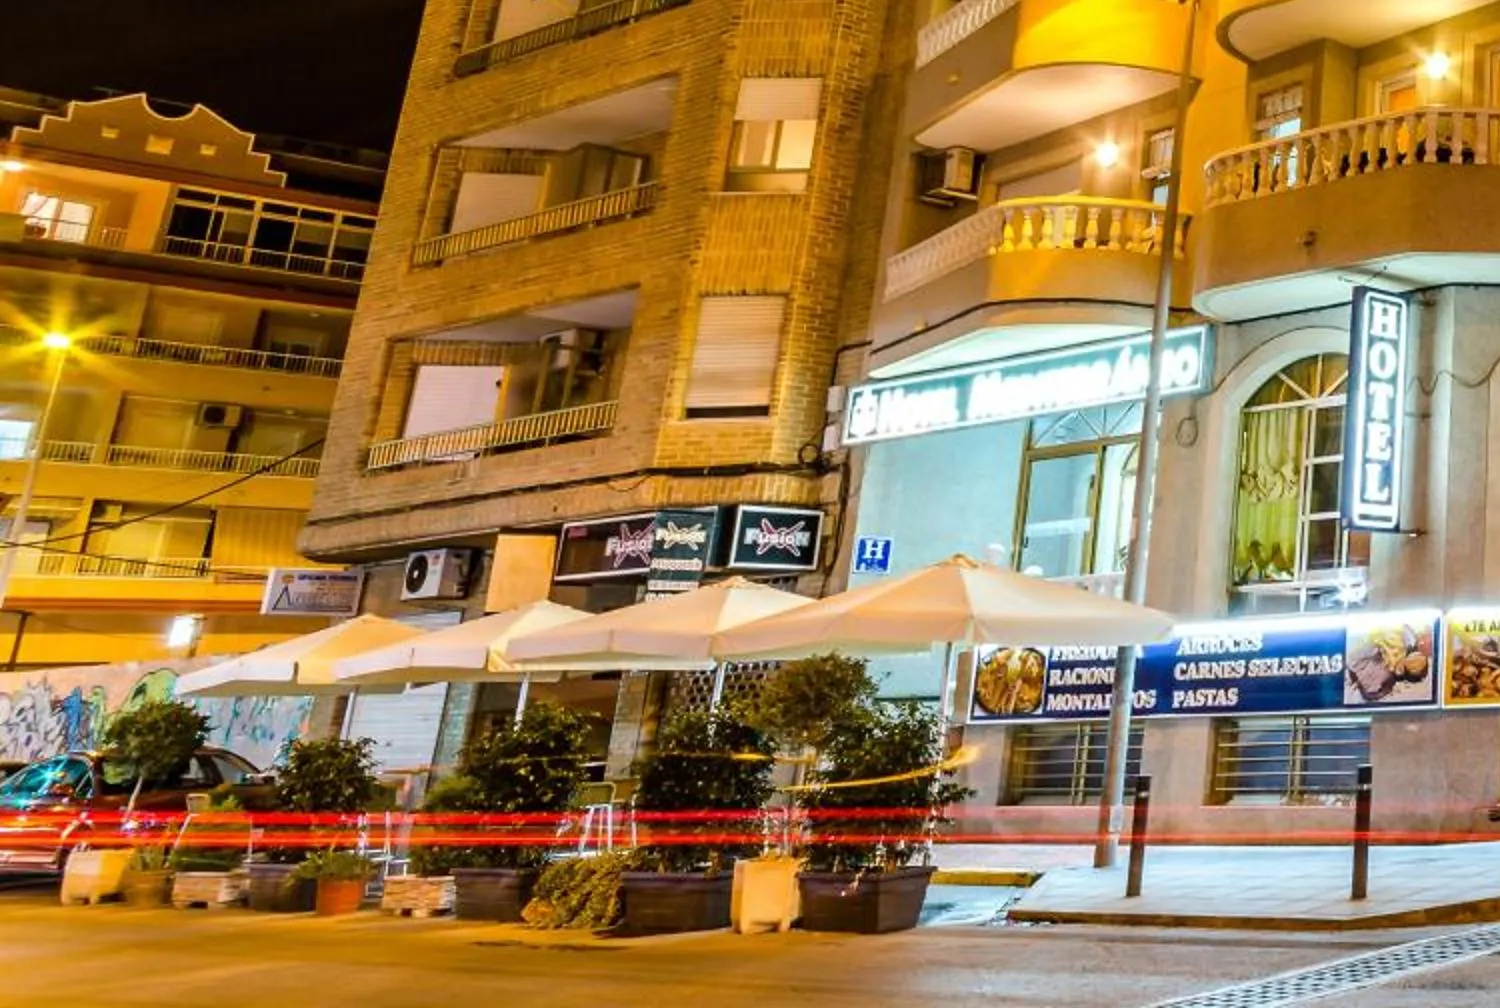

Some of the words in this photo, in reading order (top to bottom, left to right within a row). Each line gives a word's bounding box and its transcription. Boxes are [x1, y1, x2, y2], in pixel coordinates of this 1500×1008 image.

[1365, 300, 1399, 502] HOTEL
[862, 539, 885, 559] H
[1173, 659, 1246, 681] CARNES
[1247, 653, 1343, 677] SELECTAS
[1172, 687, 1239, 708] PASTAS
